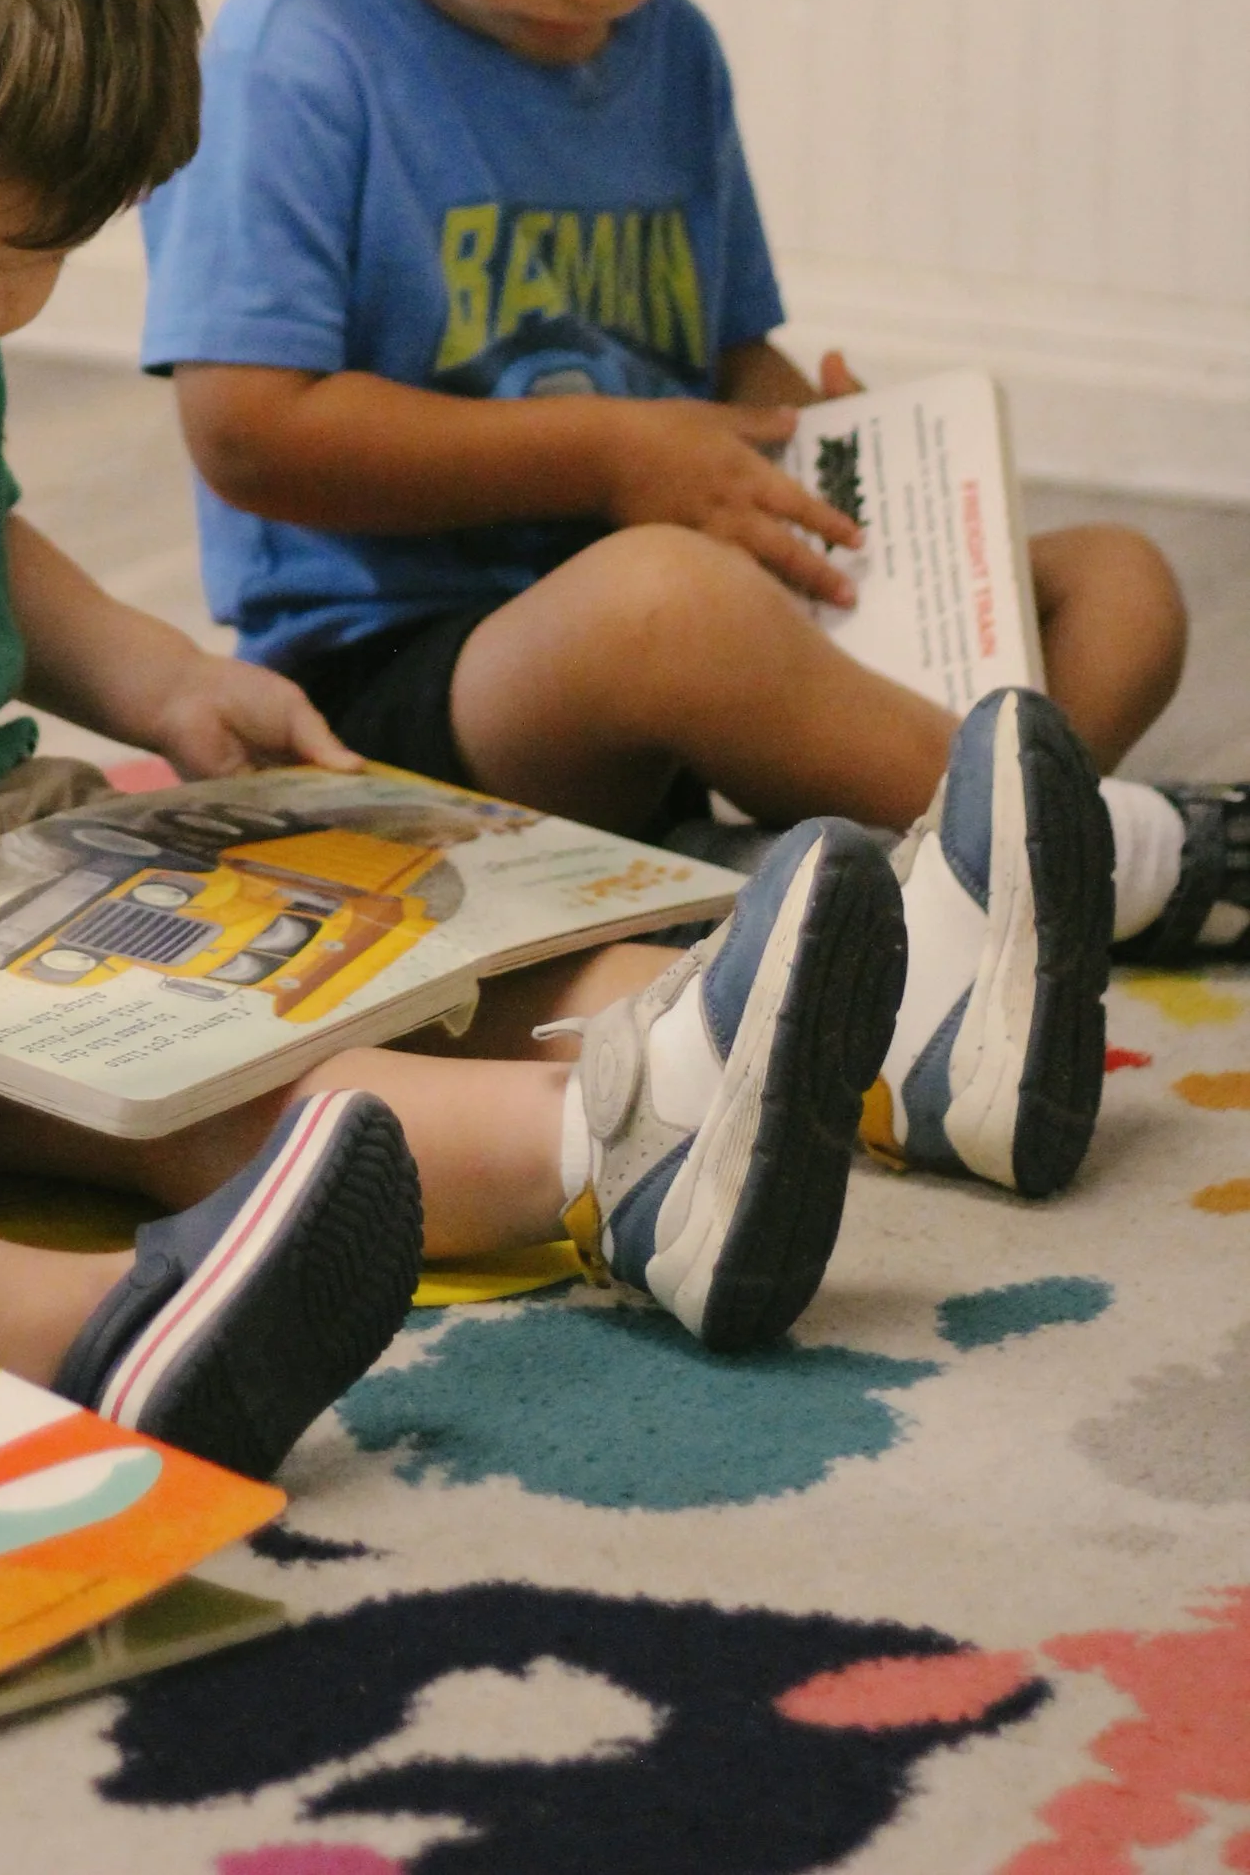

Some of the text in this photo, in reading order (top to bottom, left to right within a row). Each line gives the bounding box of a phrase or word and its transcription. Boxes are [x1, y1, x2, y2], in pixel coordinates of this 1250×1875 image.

[52, 991, 107, 1013] along
[107, 1000, 153, 1017] with
[28, 1011, 64, 1025] the
[61, 1015, 111, 1037] every
[172, 1011, 242, 1039] haven't
[114, 1018, 156, 1039] pass
[85, 1036, 121, 1051] the
[142, 1035, 175, 1053] got
[50, 1048, 91, 1065] day
[104, 1050, 149, 1068] time
